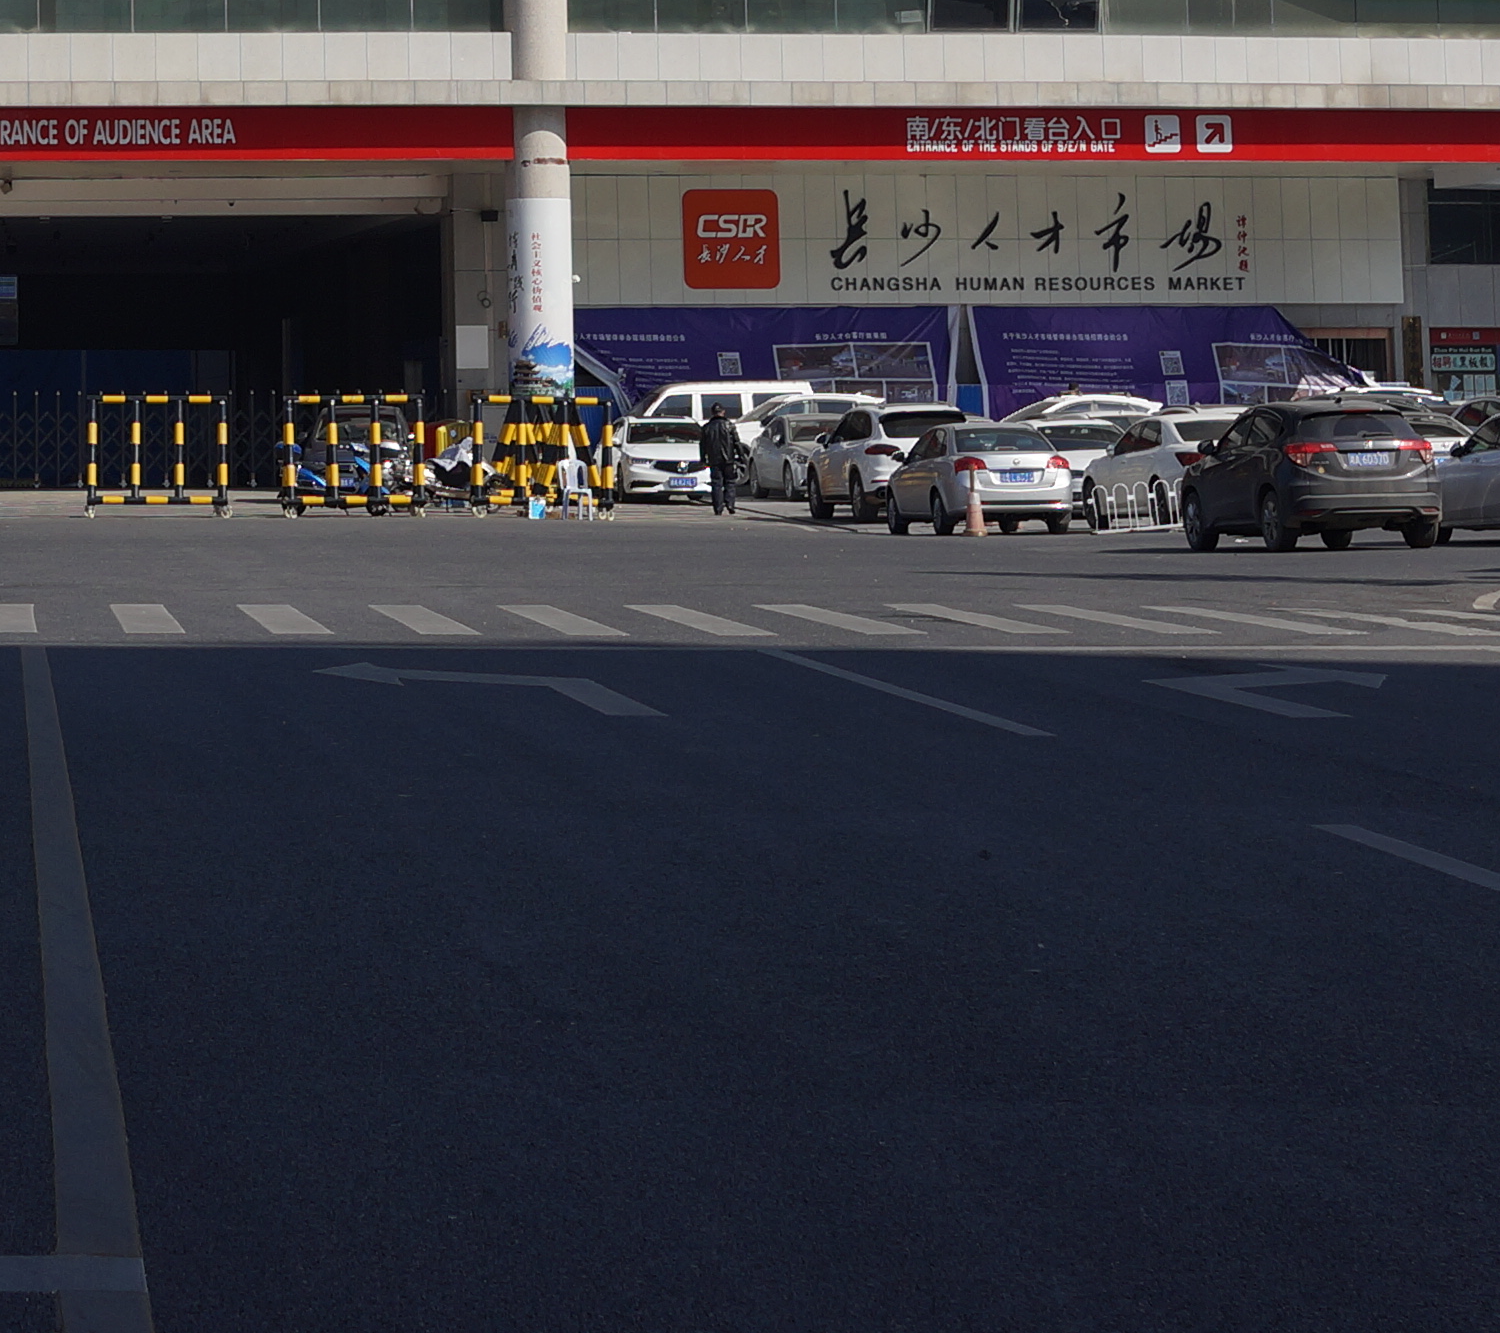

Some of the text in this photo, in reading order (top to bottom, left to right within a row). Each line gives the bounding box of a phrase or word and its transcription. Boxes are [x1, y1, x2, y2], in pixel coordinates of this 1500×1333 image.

[65, 118, 93, 145] OF
[93, 118, 181, 145] AUDIENCE
[188, 118, 237, 144] AREA
[906, 115, 1121, 140] 南/东/北门看台入口
[906, 140, 958, 152] ENTRANCE
[961, 140, 975, 152] OF
[978, 140, 997, 152] THE
[1000, 140, 1038, 152] STANDS
[1041, 140, 1053, 152] OF
[1090, 140, 1116, 152] GATE
[830, 276, 1246, 292] CHANGSHA HUMAN RESOURCES MARKET
